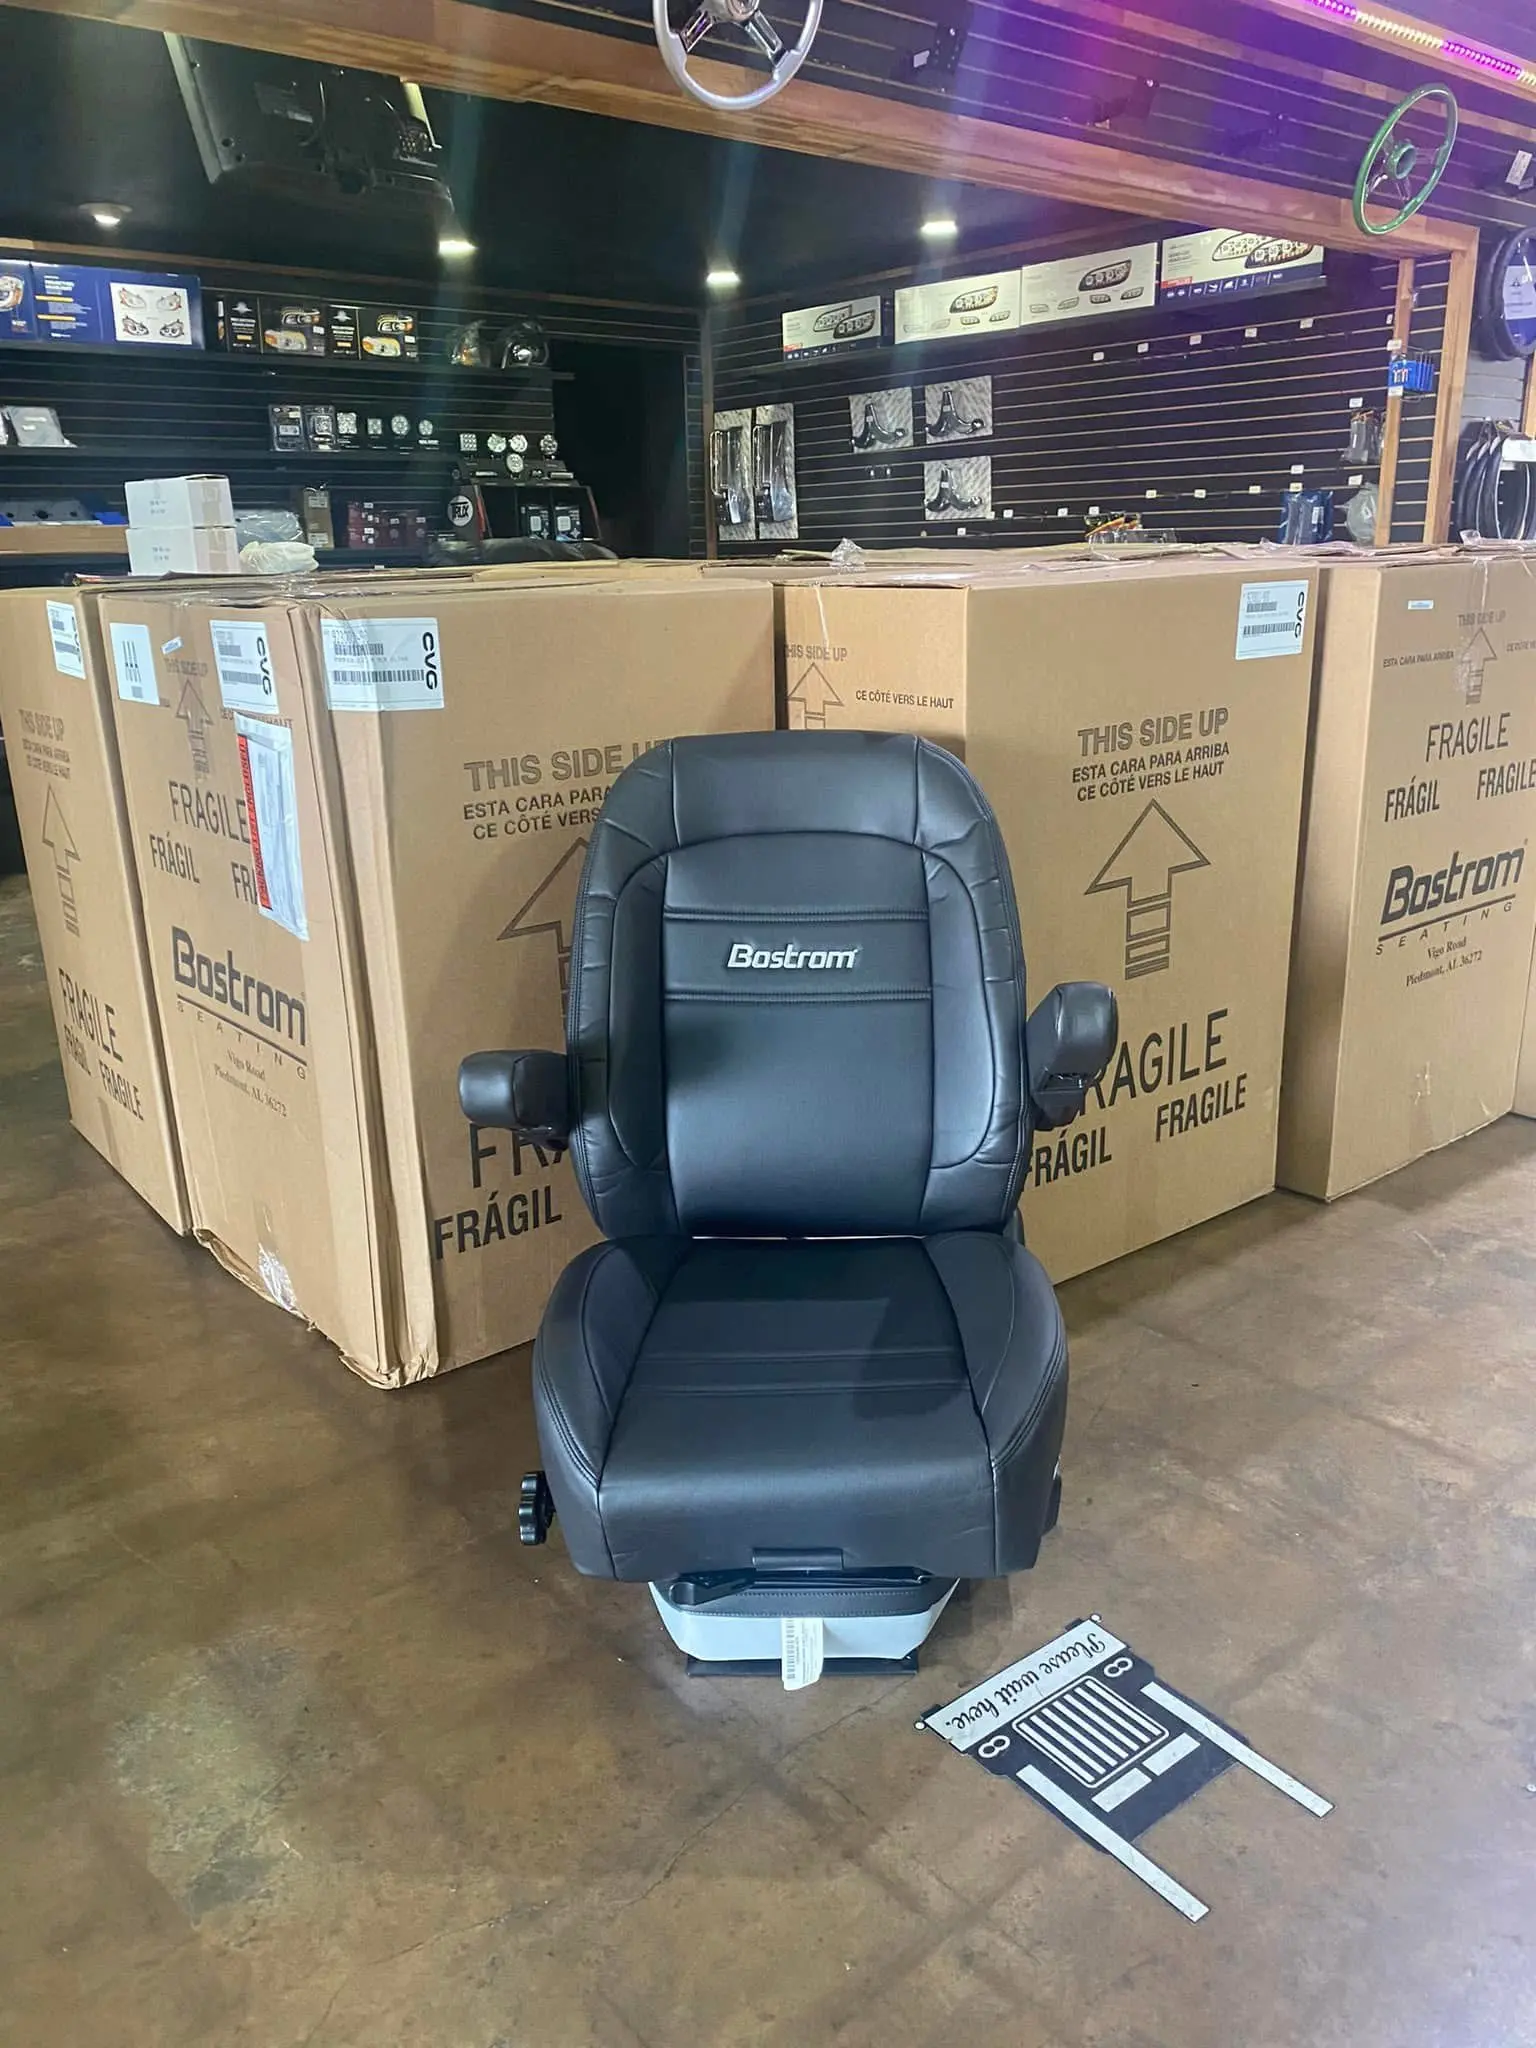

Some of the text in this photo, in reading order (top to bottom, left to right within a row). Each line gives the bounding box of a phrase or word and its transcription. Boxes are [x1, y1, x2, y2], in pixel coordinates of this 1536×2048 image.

[256, 635, 273, 696] CVG
[422, 631, 438, 690] CVG
[784, 643, 848, 661] HIS SIDE UP
[855, 689, 954, 709] CE CÔTÉ VERS LE HAUT
[1077, 707, 1230, 757] THIS SIDE UP
[1426, 712, 1511, 763] FRAGILE
[464, 754, 542, 792] THIS
[551, 744, 624, 780] SIDE
[1072, 742, 1230, 783] ESTA CARA PARA ARRIBA
[1077, 760, 1225, 802] CE CÔTÉ VERS LE HAUT
[1384, 758, 1536, 822] FRÁGIL FRAGILE
[168, 780, 251, 845] FRAGILE
[463, 800, 510, 821] ESTA
[515, 792, 564, 813] CARA
[473, 807, 601, 841] CE CÔTÉ VERS
[149, 831, 200, 884] FRÁGIL
[1380, 847, 1525, 926] Bostrom
[727, 942, 858, 970] Bostrom
[1375, 901, 1513, 957] SEATING
[1426, 936, 1467, 960] Vigo Road
[171, 925, 306, 1047] Bostrom
[1459, 950, 1483, 968] 36272
[58, 966, 124, 1064] FRAGILE
[177, 999, 308, 1081] SEATING
[98, 1058, 144, 1122] FRAGILE
[1079, 1008, 1229, 1117] RAGILE
[1155, 1072, 1248, 1143] FRAGILE
[433, 1186, 562, 1260] FRÁGIL
[945, 1631, 1107, 1731] Please wait here.
